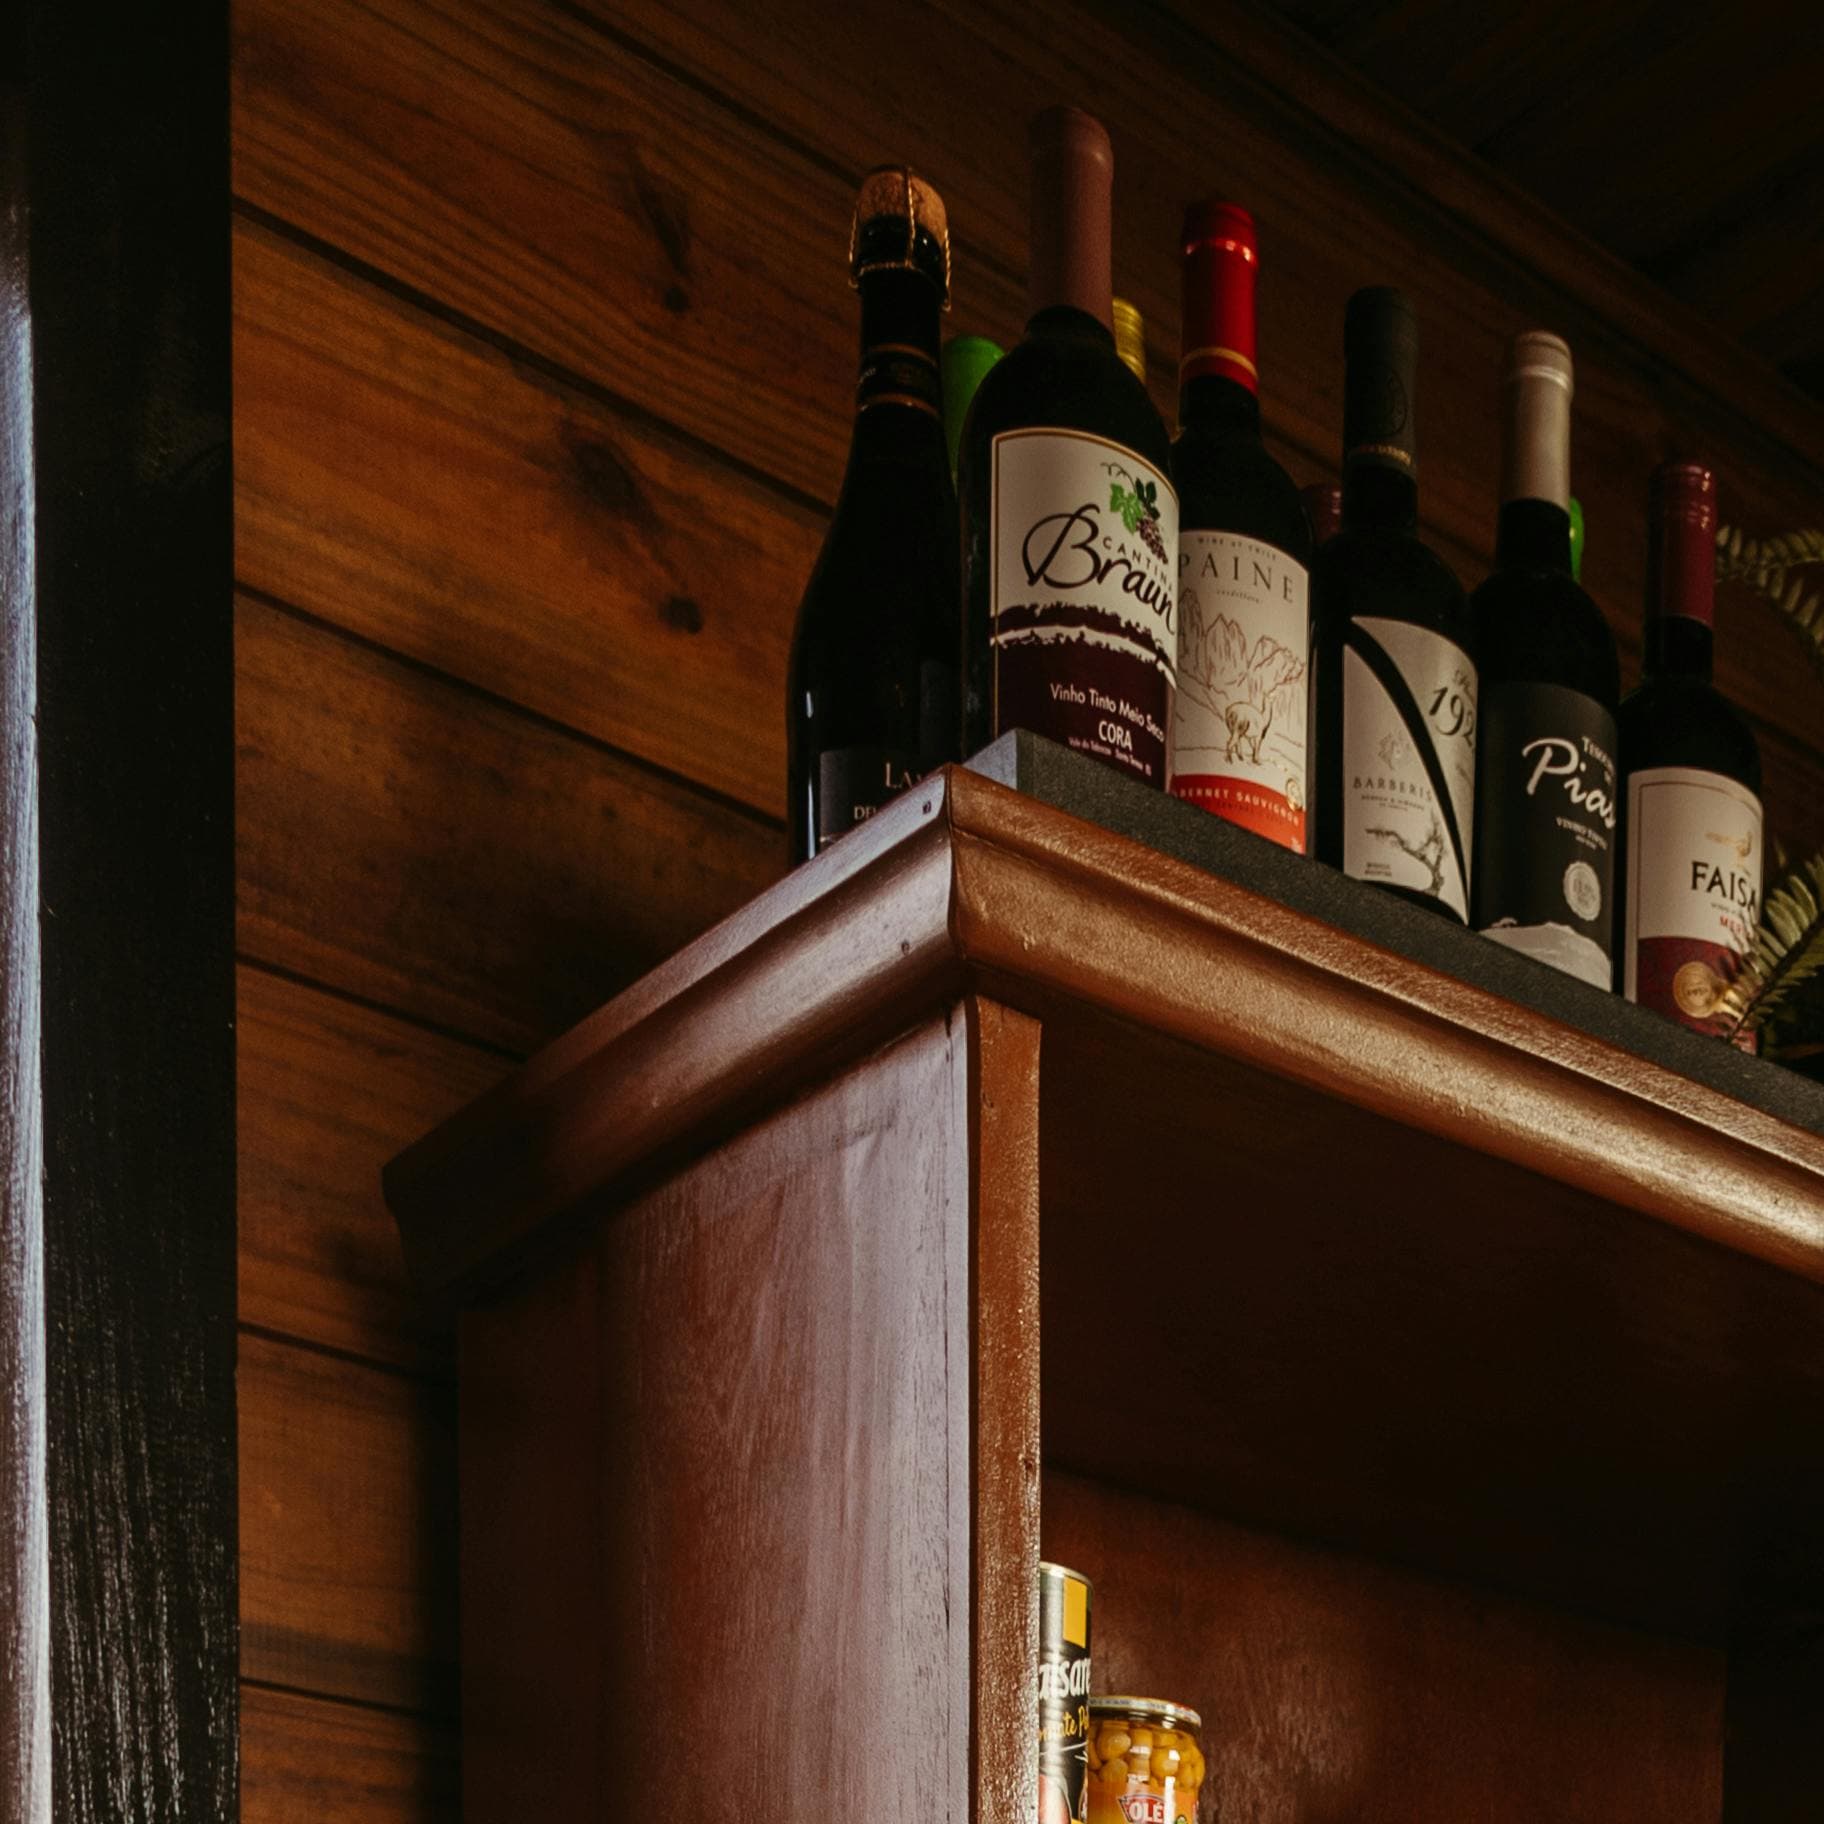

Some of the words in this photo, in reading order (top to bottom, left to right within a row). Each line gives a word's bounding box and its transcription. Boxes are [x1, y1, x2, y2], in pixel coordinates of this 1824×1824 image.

[1023, 503, 1176, 636] Braun
[1178, 553, 1294, 603] PAINE
[1050, 682, 1086, 705] Vinho
[1089, 687, 1117, 713] Tinto
[1119, 698, 1145, 727] Meio
[1098, 719, 1133, 751] CORA
[1236, 791, 1299, 827] SAUVIGNON
[1353, 776, 1433, 802] BARBERIS
